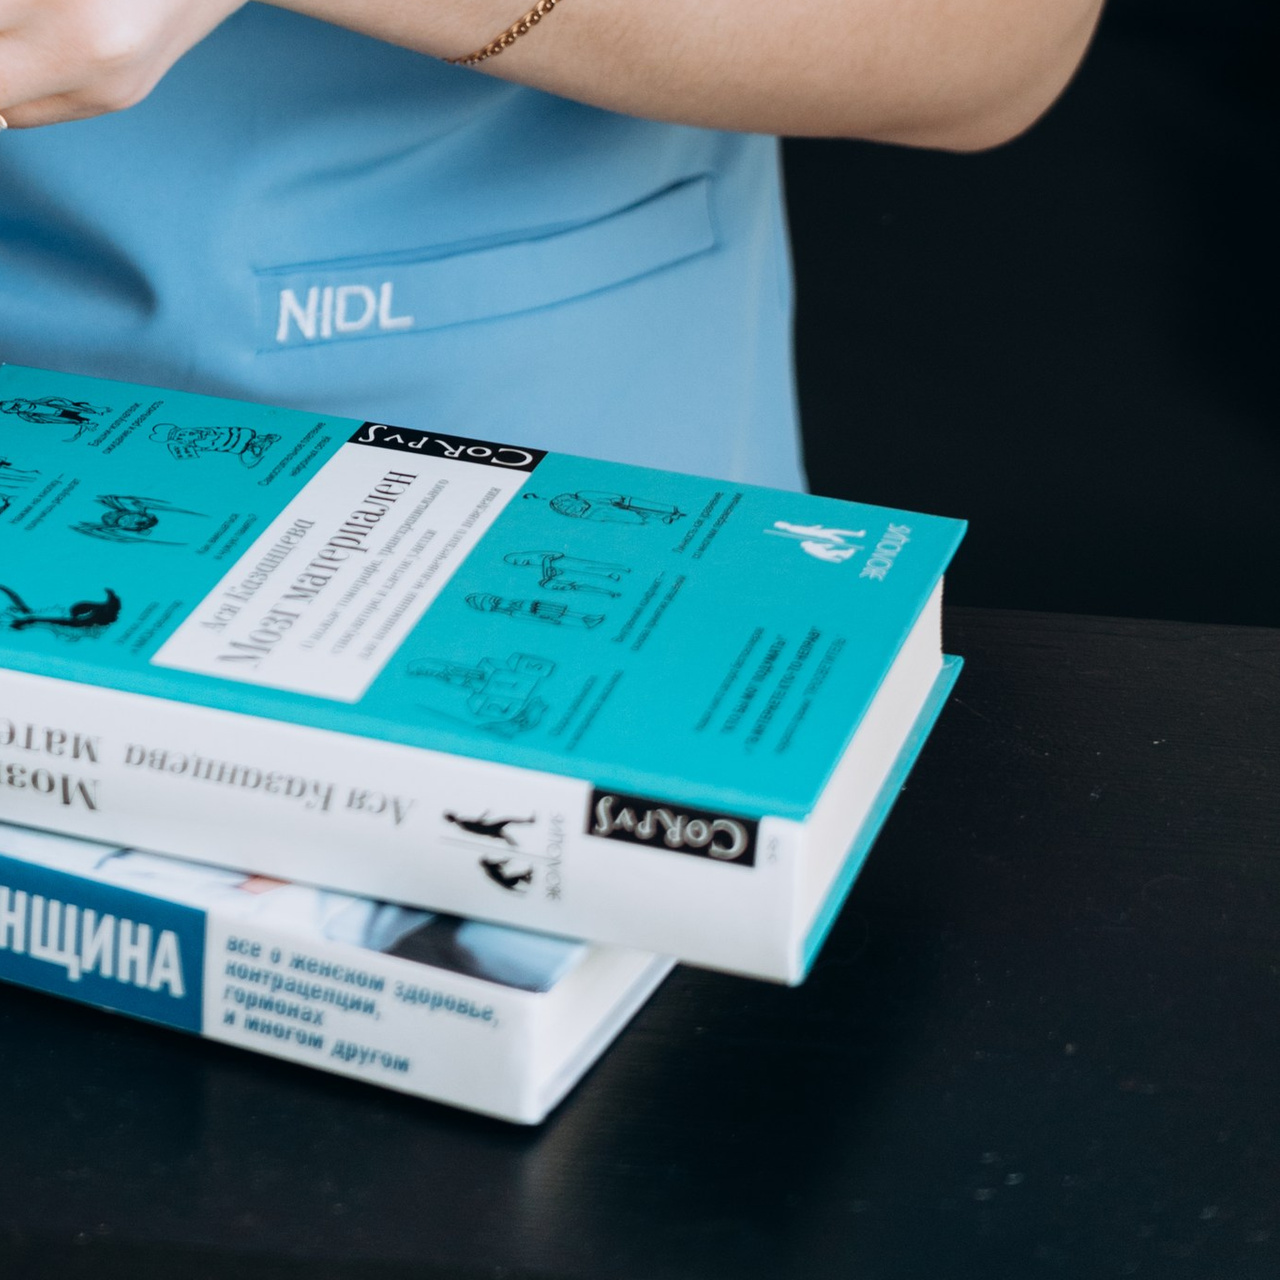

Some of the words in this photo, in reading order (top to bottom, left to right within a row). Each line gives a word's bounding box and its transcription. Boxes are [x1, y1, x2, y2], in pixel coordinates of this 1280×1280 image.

[276, 281, 414, 342] NIDL
[199, 600, 243, 630] Ася
[237, 518, 315, 601] Казанцева
[217, 605, 291, 669] Мозг
[289, 470, 418, 605] материален
[124, 742, 337, 811] Казанцева
[345, 786, 416, 826] Ася
[225, 935, 262, 958] все
[269, 948, 281, 964] о
[289, 952, 385, 992] женском
[225, 960, 382, 1022] контрацепции,
[224, 984, 325, 1025] гормонах
[223, 1009, 235, 1025] и
[244, 1014, 325, 1050] многом
[330, 1040, 410, 1073] другом
